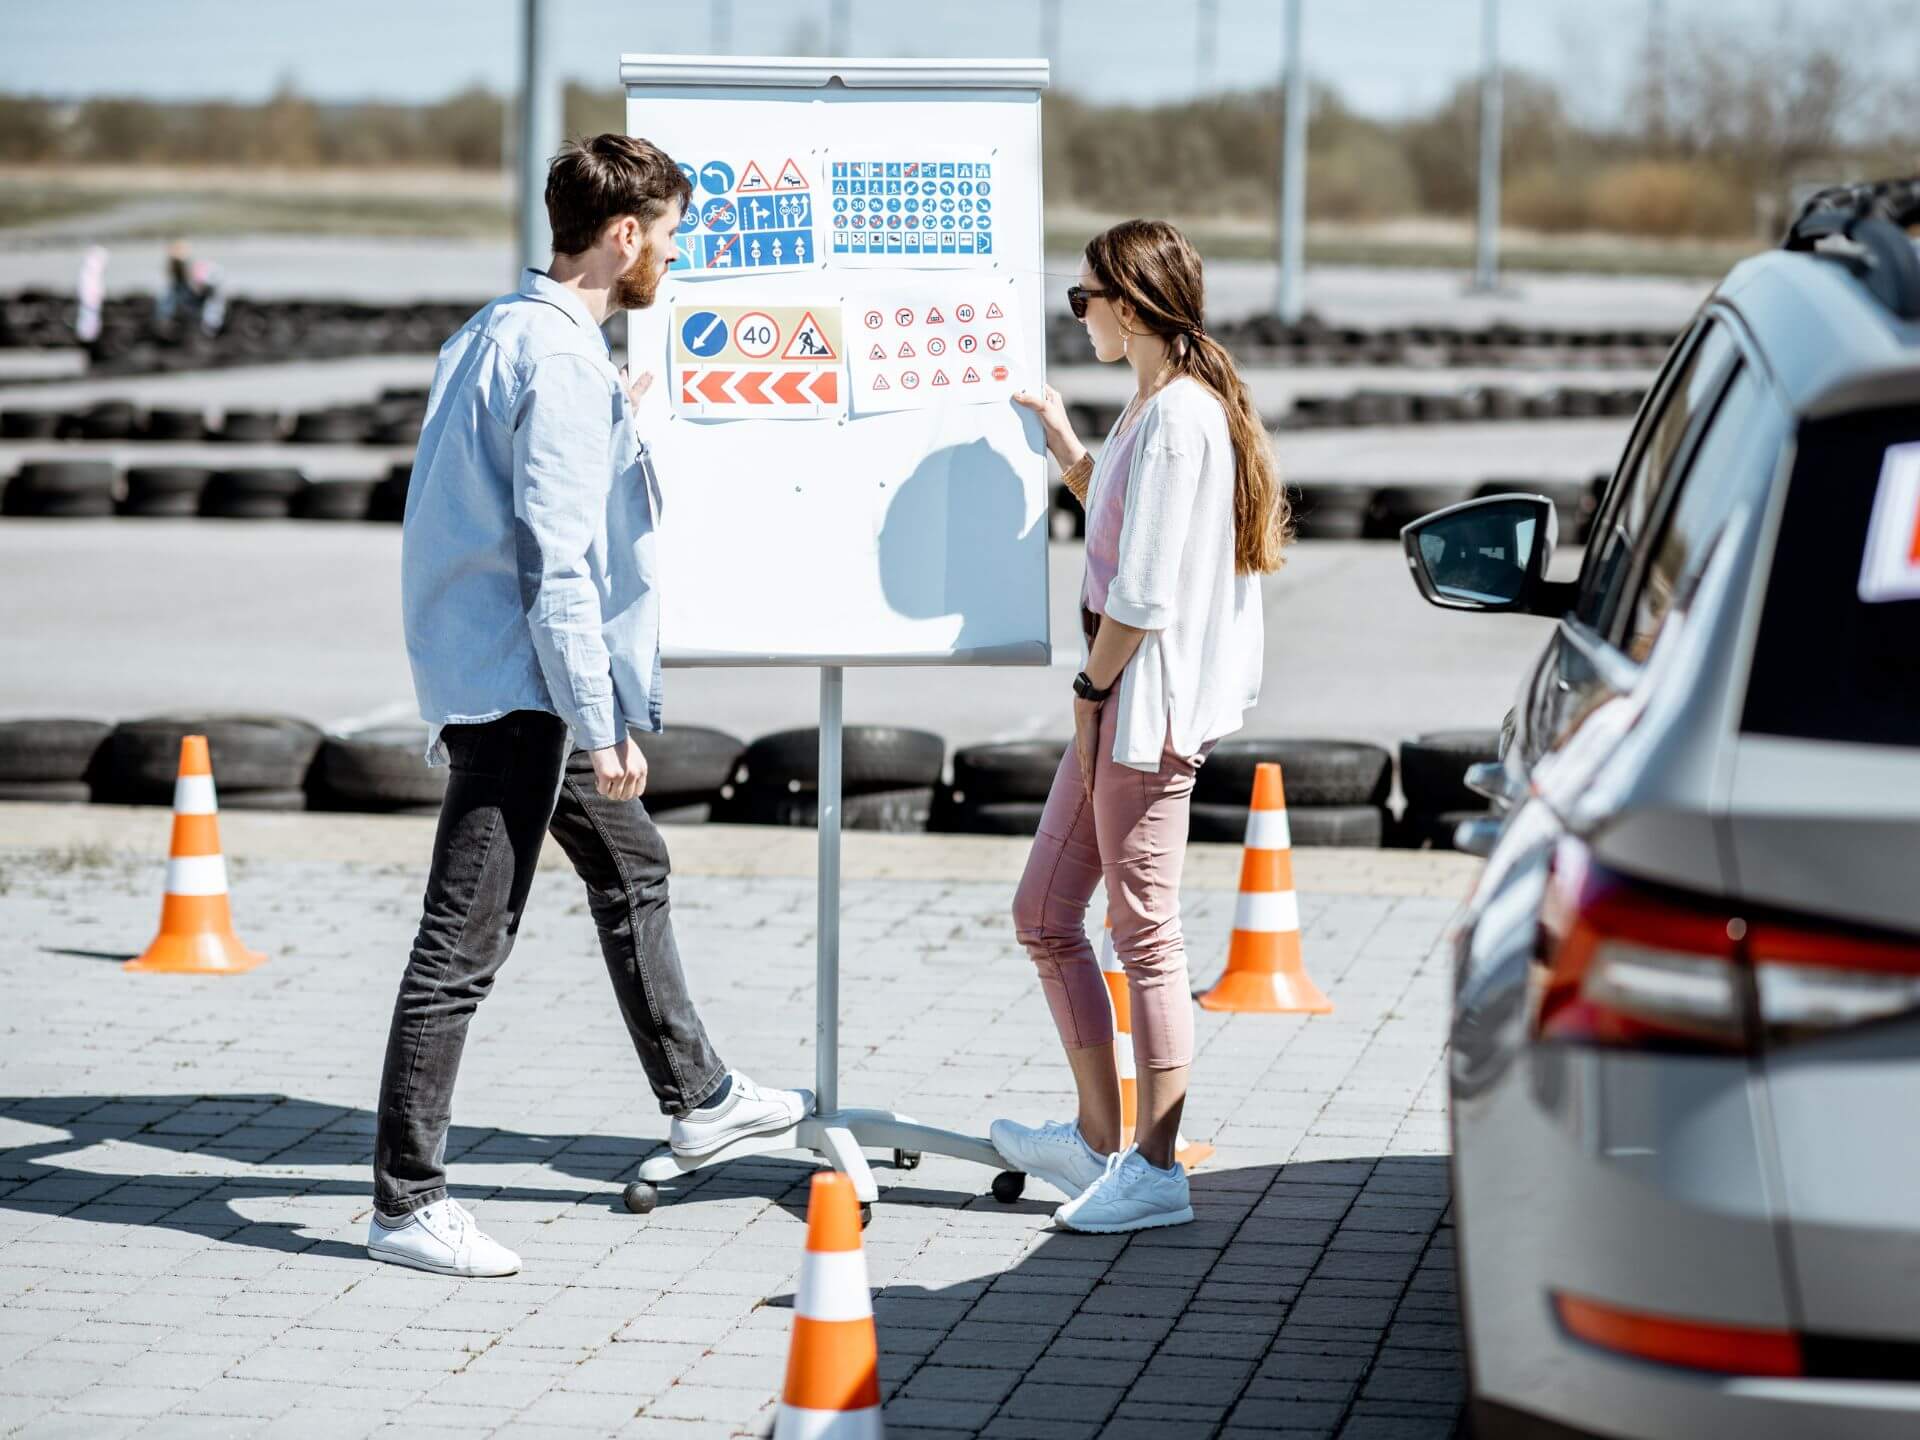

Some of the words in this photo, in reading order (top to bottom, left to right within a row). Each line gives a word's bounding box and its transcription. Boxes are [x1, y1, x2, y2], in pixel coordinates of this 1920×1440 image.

[852, 200, 864, 210] 30
[960, 309, 971, 317] 40
[743, 326, 771, 344] 40
[964, 339, 972, 349] P
